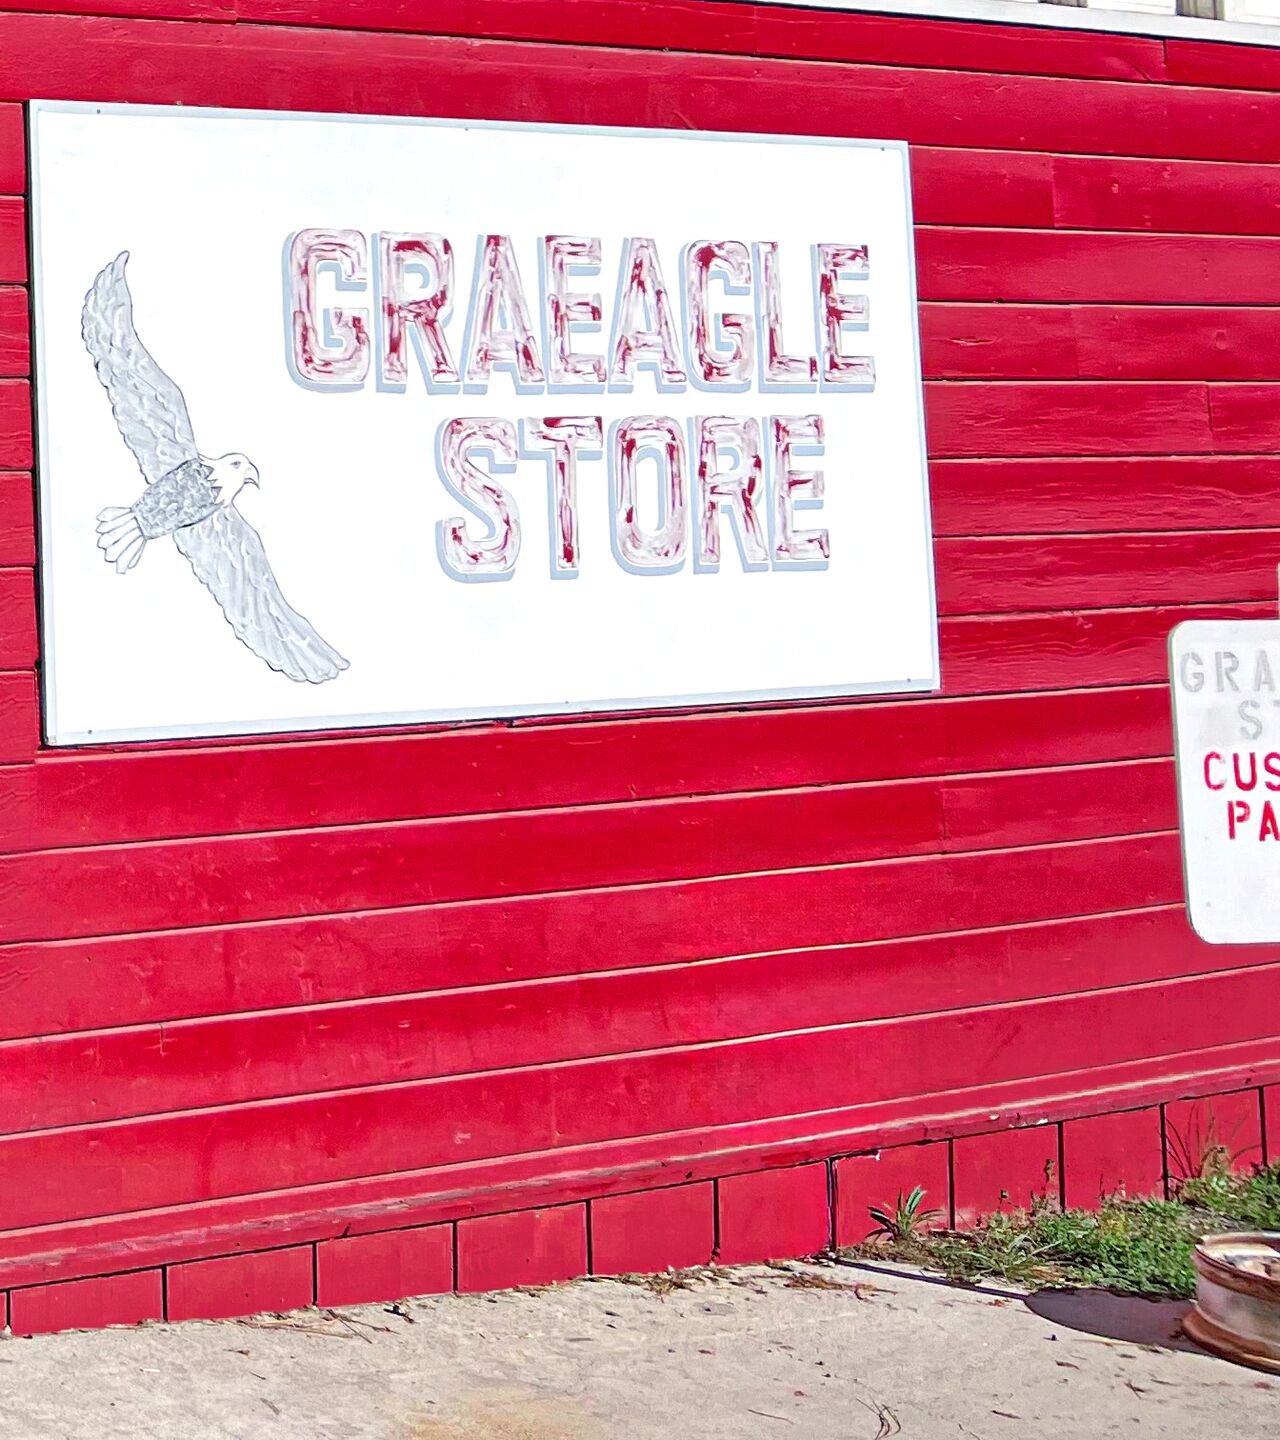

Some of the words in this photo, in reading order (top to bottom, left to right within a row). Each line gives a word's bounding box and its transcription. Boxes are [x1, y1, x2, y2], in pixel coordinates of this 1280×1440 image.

[284, 228, 876, 394] GRAEAGLE
[435, 415, 831, 583] STORE
[1238, 699, 1280, 741] S
[1204, 751, 1280, 792] CUS
[1227, 800, 1280, 842] PA
